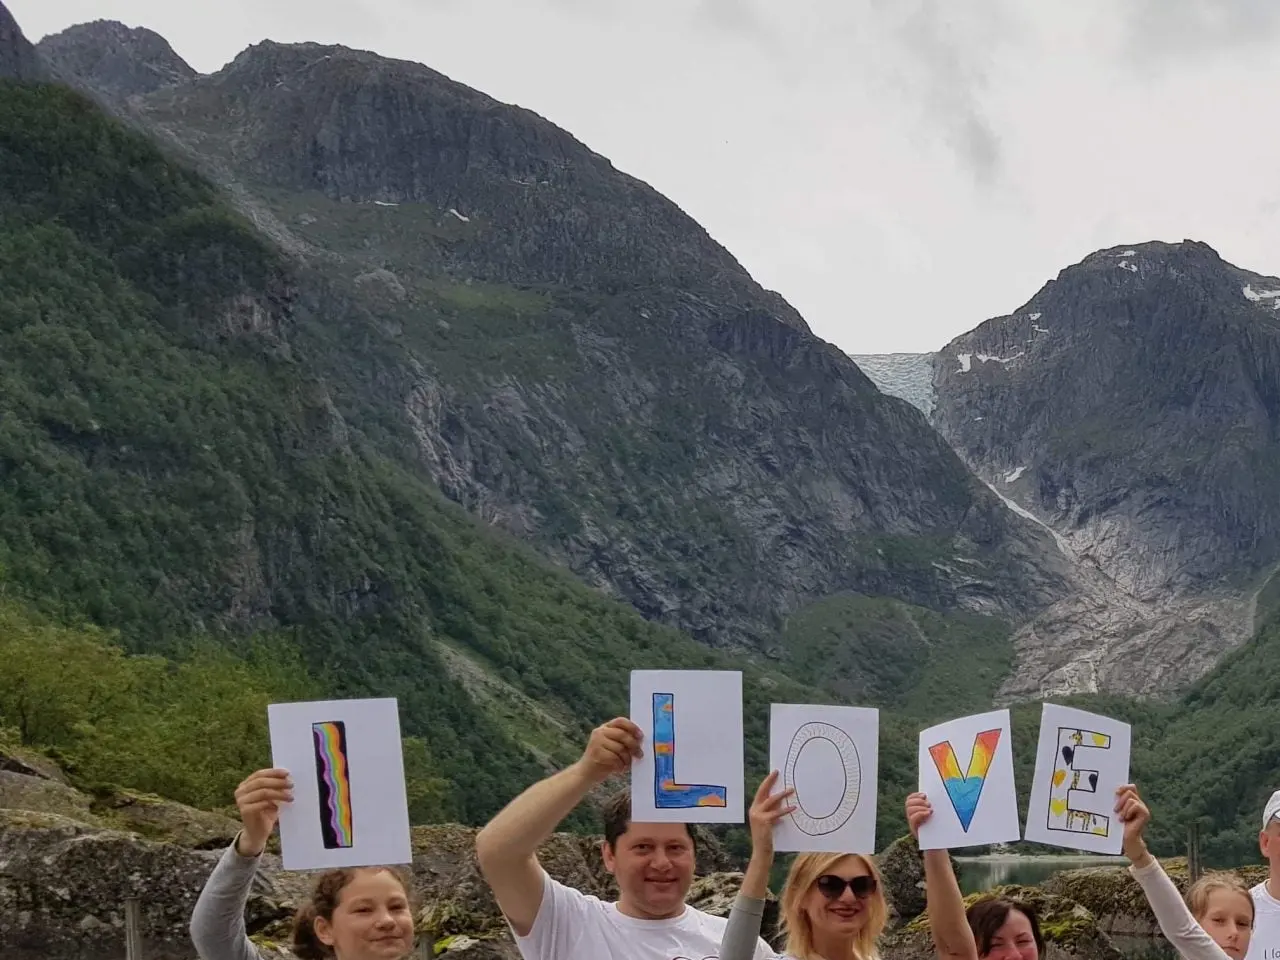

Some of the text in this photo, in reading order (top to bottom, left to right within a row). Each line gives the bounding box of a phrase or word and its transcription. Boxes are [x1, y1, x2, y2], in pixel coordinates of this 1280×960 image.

[312, 721, 353, 848] I
[653, 693, 1110, 837] L O V E
